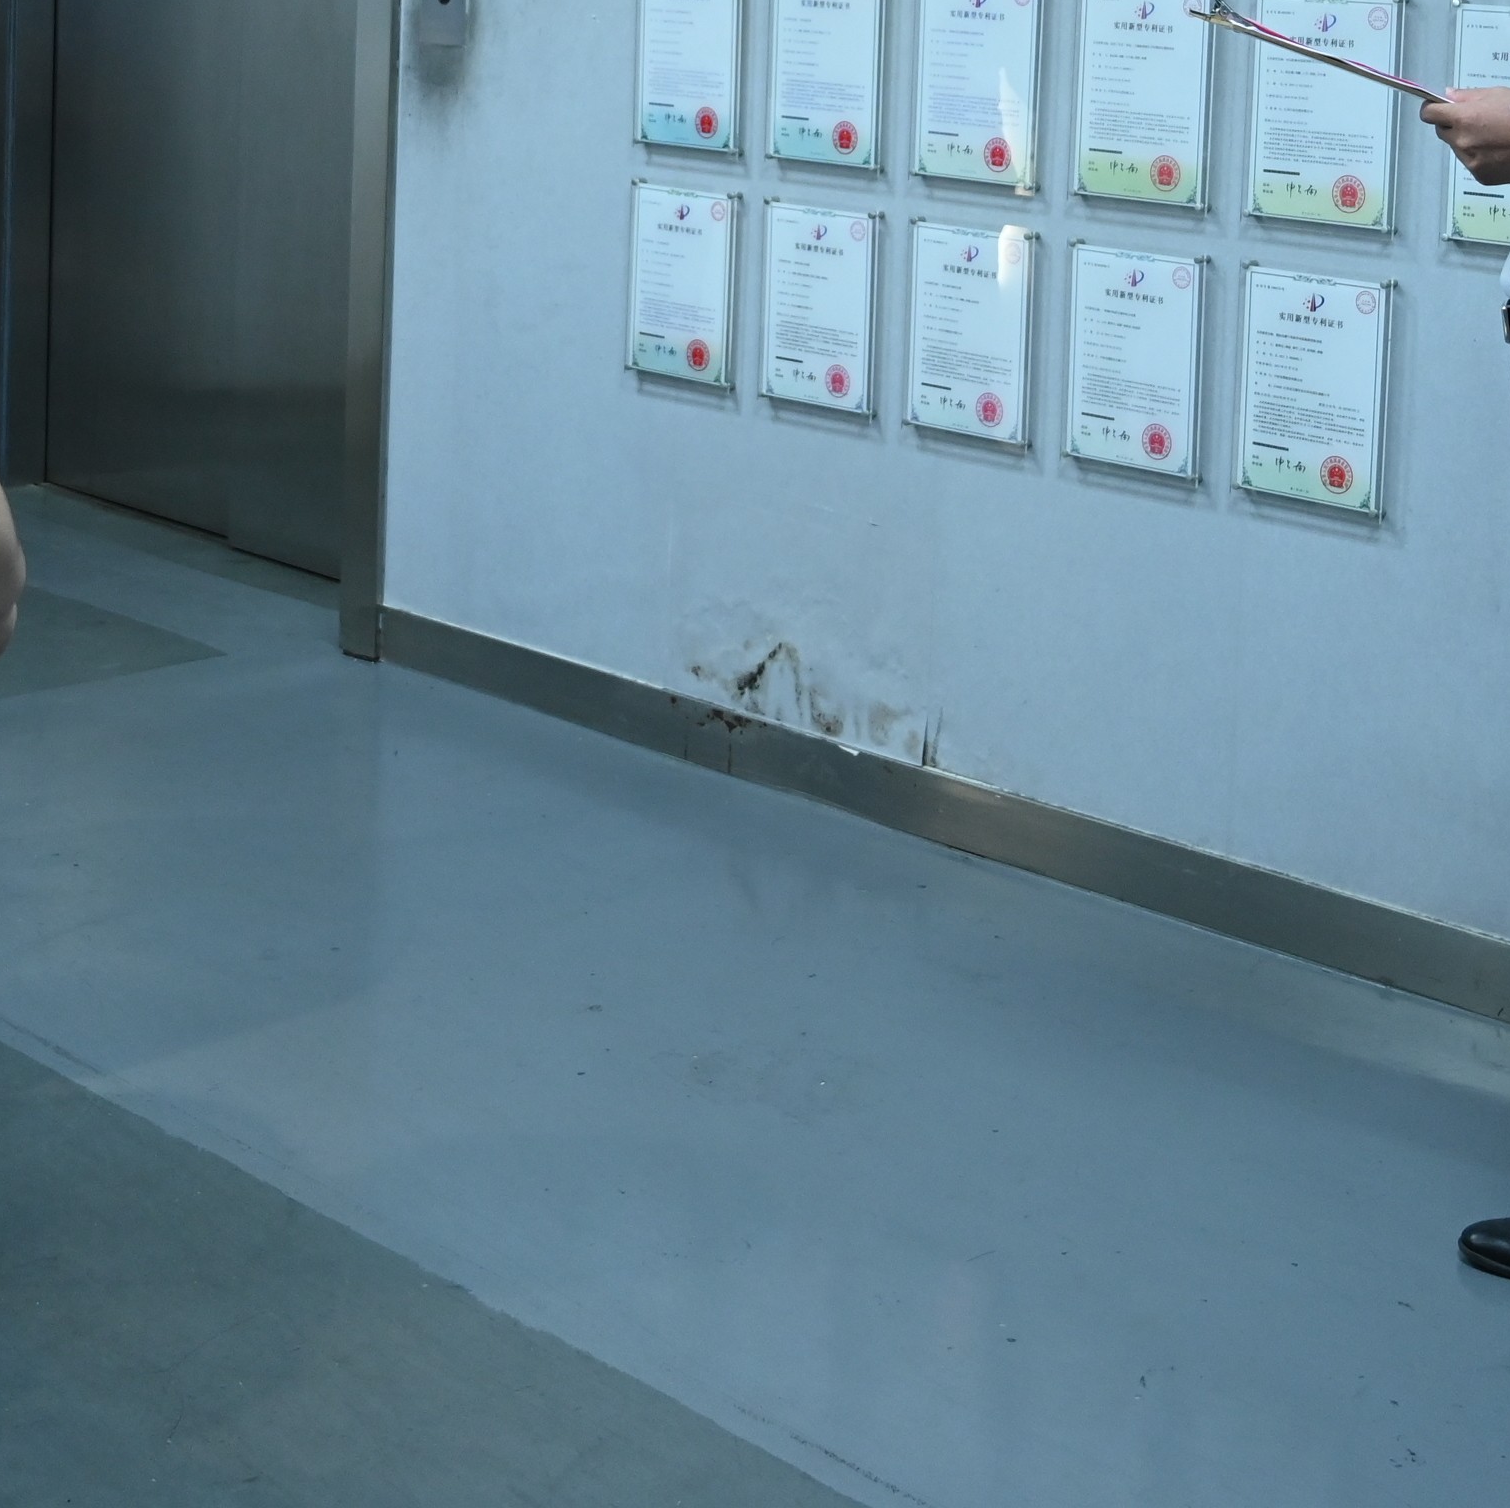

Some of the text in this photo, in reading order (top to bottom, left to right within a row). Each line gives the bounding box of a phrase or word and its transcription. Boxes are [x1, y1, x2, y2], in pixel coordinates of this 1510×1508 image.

[1113, 21, 1174, 35] 实用新型专利证书
[1105, 288, 1165, 305] 实用新型专利证书
[1278, 312, 1344, 330] 实用新型专利证书
